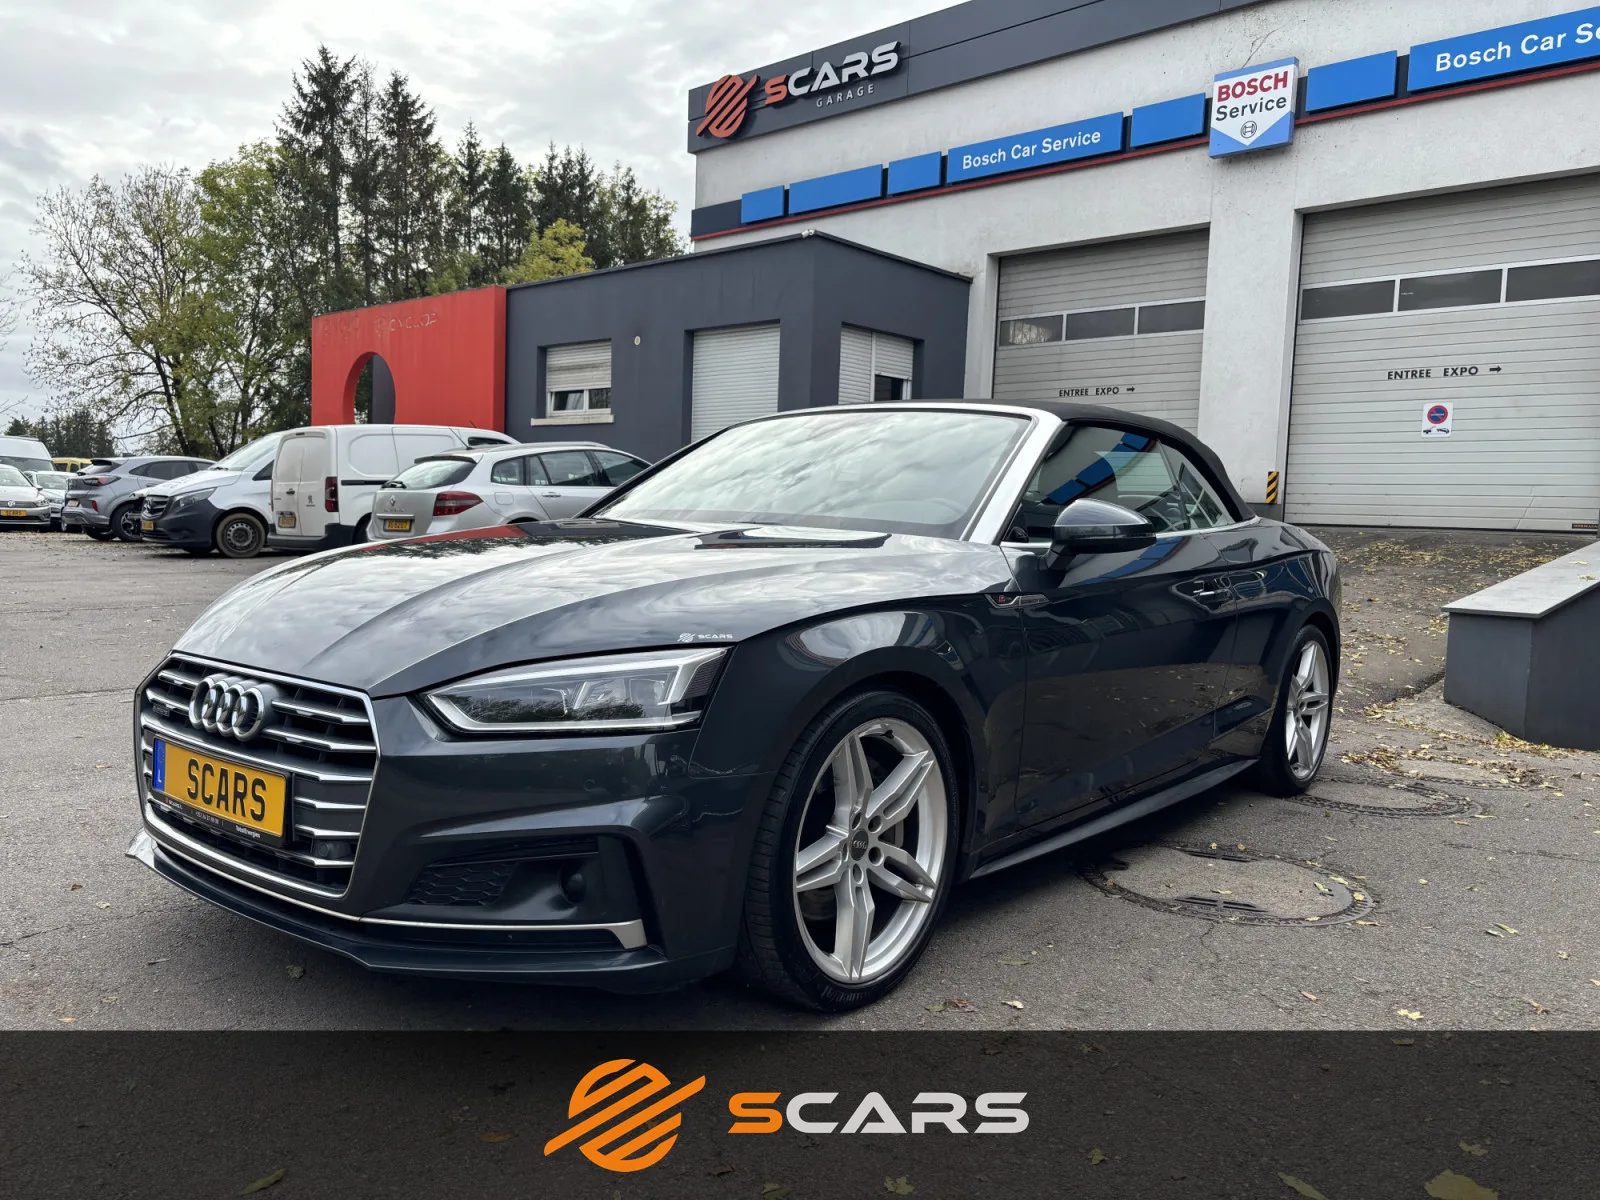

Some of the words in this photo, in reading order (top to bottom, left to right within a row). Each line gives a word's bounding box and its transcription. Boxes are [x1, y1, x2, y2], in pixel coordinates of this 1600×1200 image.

[1435, 41, 1511, 72] Bosch
[1520, 32, 1567, 55] Car
[764, 40, 899, 105] SCARS
[1217, 70, 1289, 103] BOSCH
[816, 83, 875, 108] GARAGE
[1215, 96, 1287, 122] Service
[962, 148, 1006, 170] Bosch
[1011, 144, 1037, 159] Car
[1041, 131, 1102, 154] Service
[1386, 368, 1432, 380] ENTREE
[1443, 365, 1479, 377] EXPO
[1059, 388, 1089, 397] ENTREE
[1095, 386, 1119, 396] EXPO
[187, 758, 266, 822] SCARS
